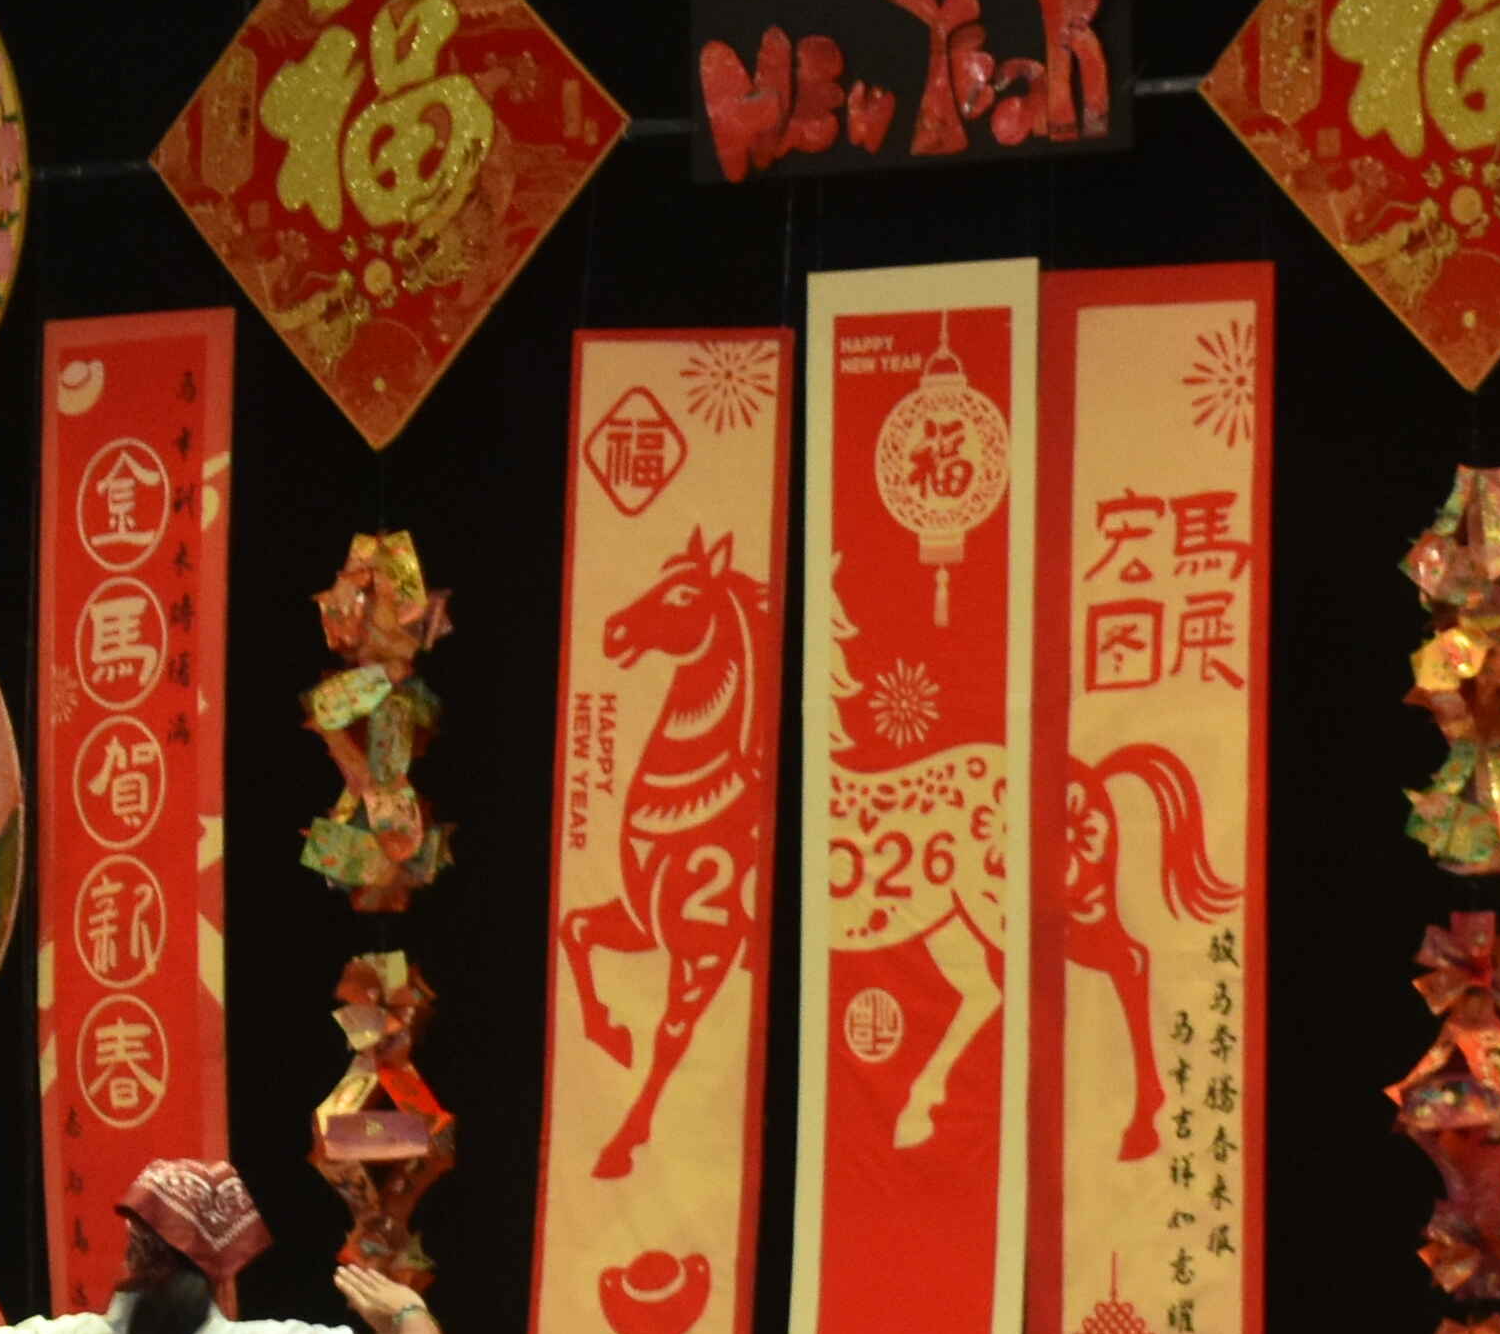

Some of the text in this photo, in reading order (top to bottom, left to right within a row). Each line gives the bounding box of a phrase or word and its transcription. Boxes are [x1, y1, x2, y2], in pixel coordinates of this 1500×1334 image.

[840, 334, 895, 355] HAPPY
[840, 353, 923, 374] NEW YEAR
[604, 419, 667, 489] 福
[909, 418, 974, 501] 福
[85, 451, 165, 1108] 金馬賀新春
[569, 692, 592, 850] NEW YEAR
[595, 692, 618, 797] HAPPY
